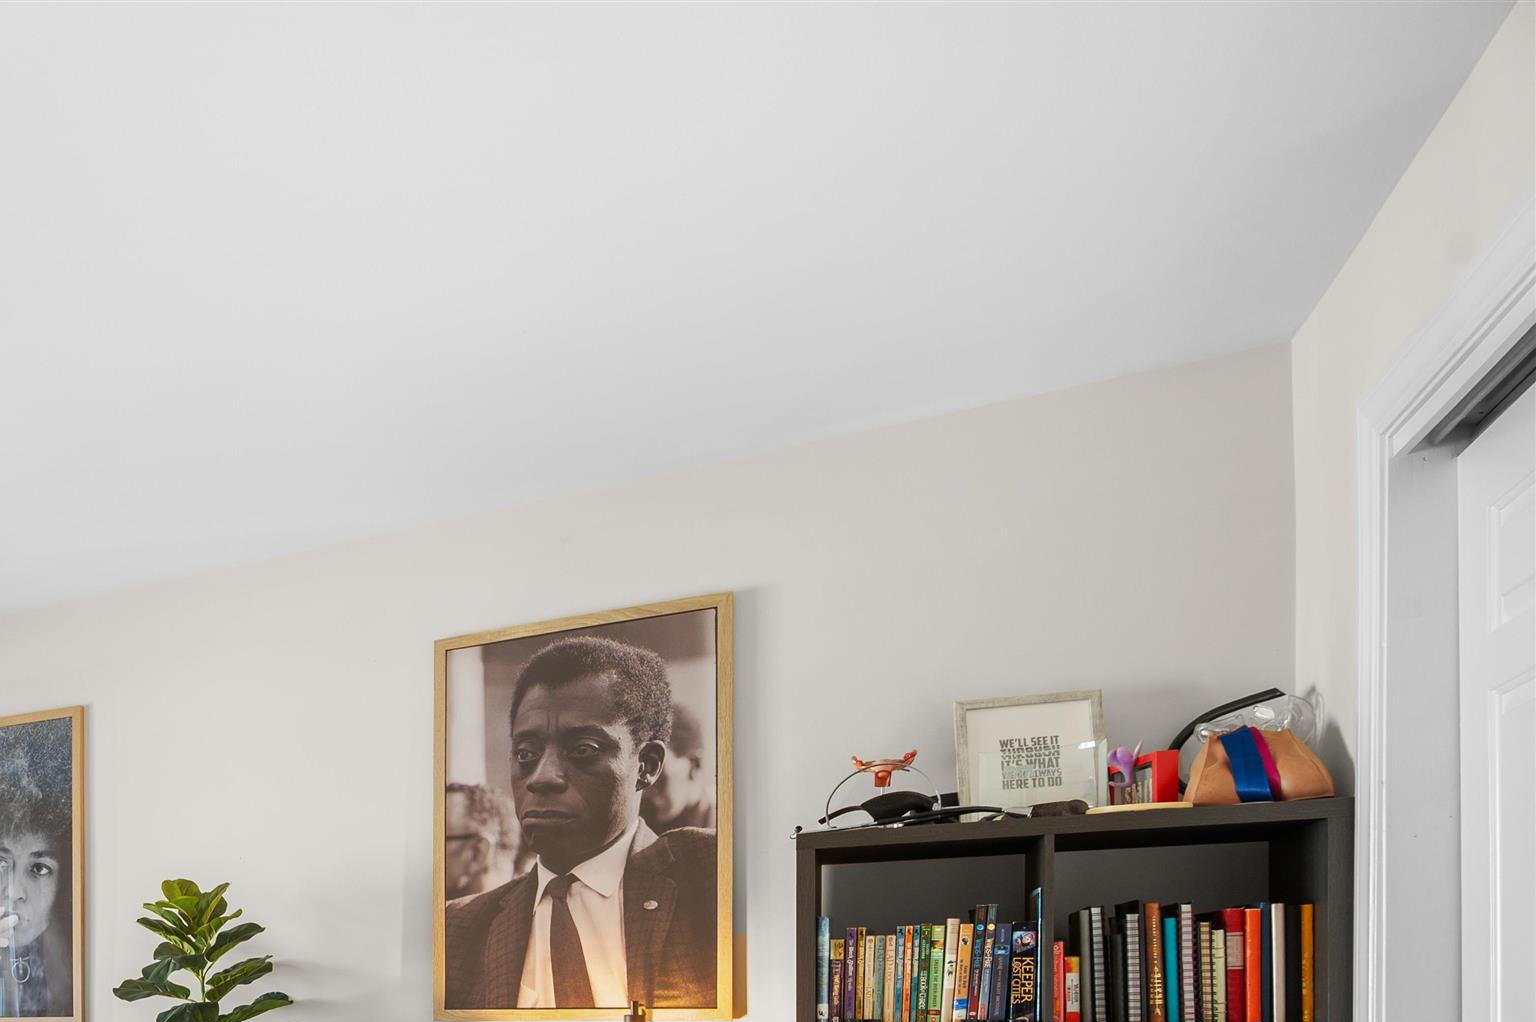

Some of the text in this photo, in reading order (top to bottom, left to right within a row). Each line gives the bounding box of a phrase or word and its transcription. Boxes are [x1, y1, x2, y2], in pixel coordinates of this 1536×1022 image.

[999, 735, 1060, 749] WE'LL SEE IT
[1026, 757, 1061, 770] WHAT
[1002, 776, 1063, 791] HERE TO DO
[1011, 957, 1023, 1005] LOST CITIES
[1021, 957, 1035, 1002] KEEPER
